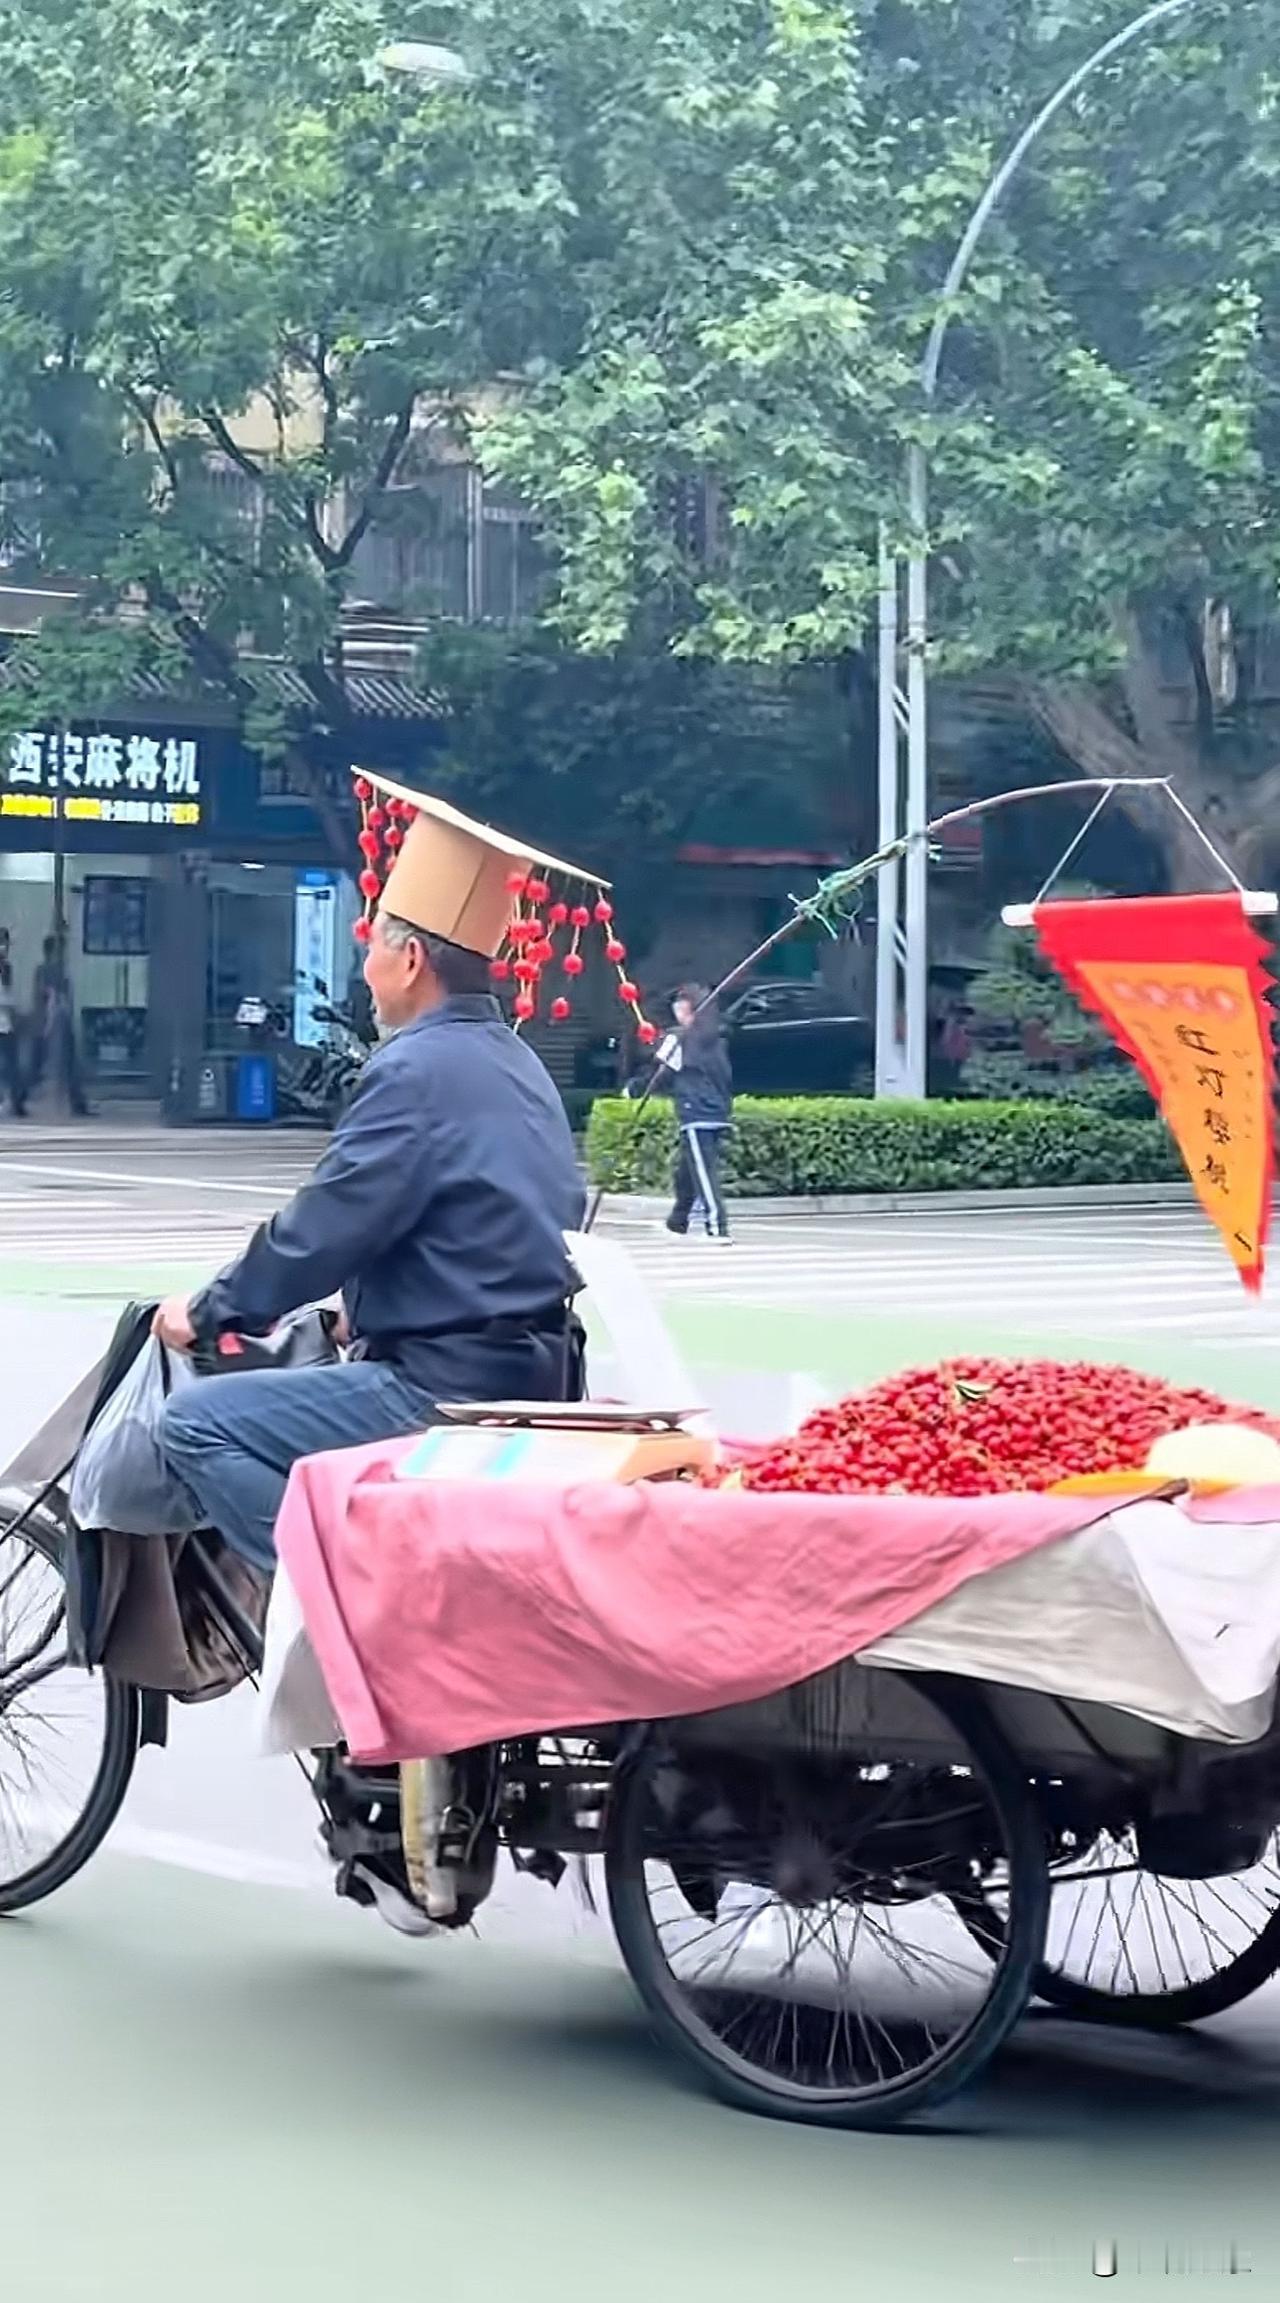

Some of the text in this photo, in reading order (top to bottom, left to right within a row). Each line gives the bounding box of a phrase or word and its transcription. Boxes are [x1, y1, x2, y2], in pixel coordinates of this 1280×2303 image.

[8, 732, 200, 793] 西安麻将机
